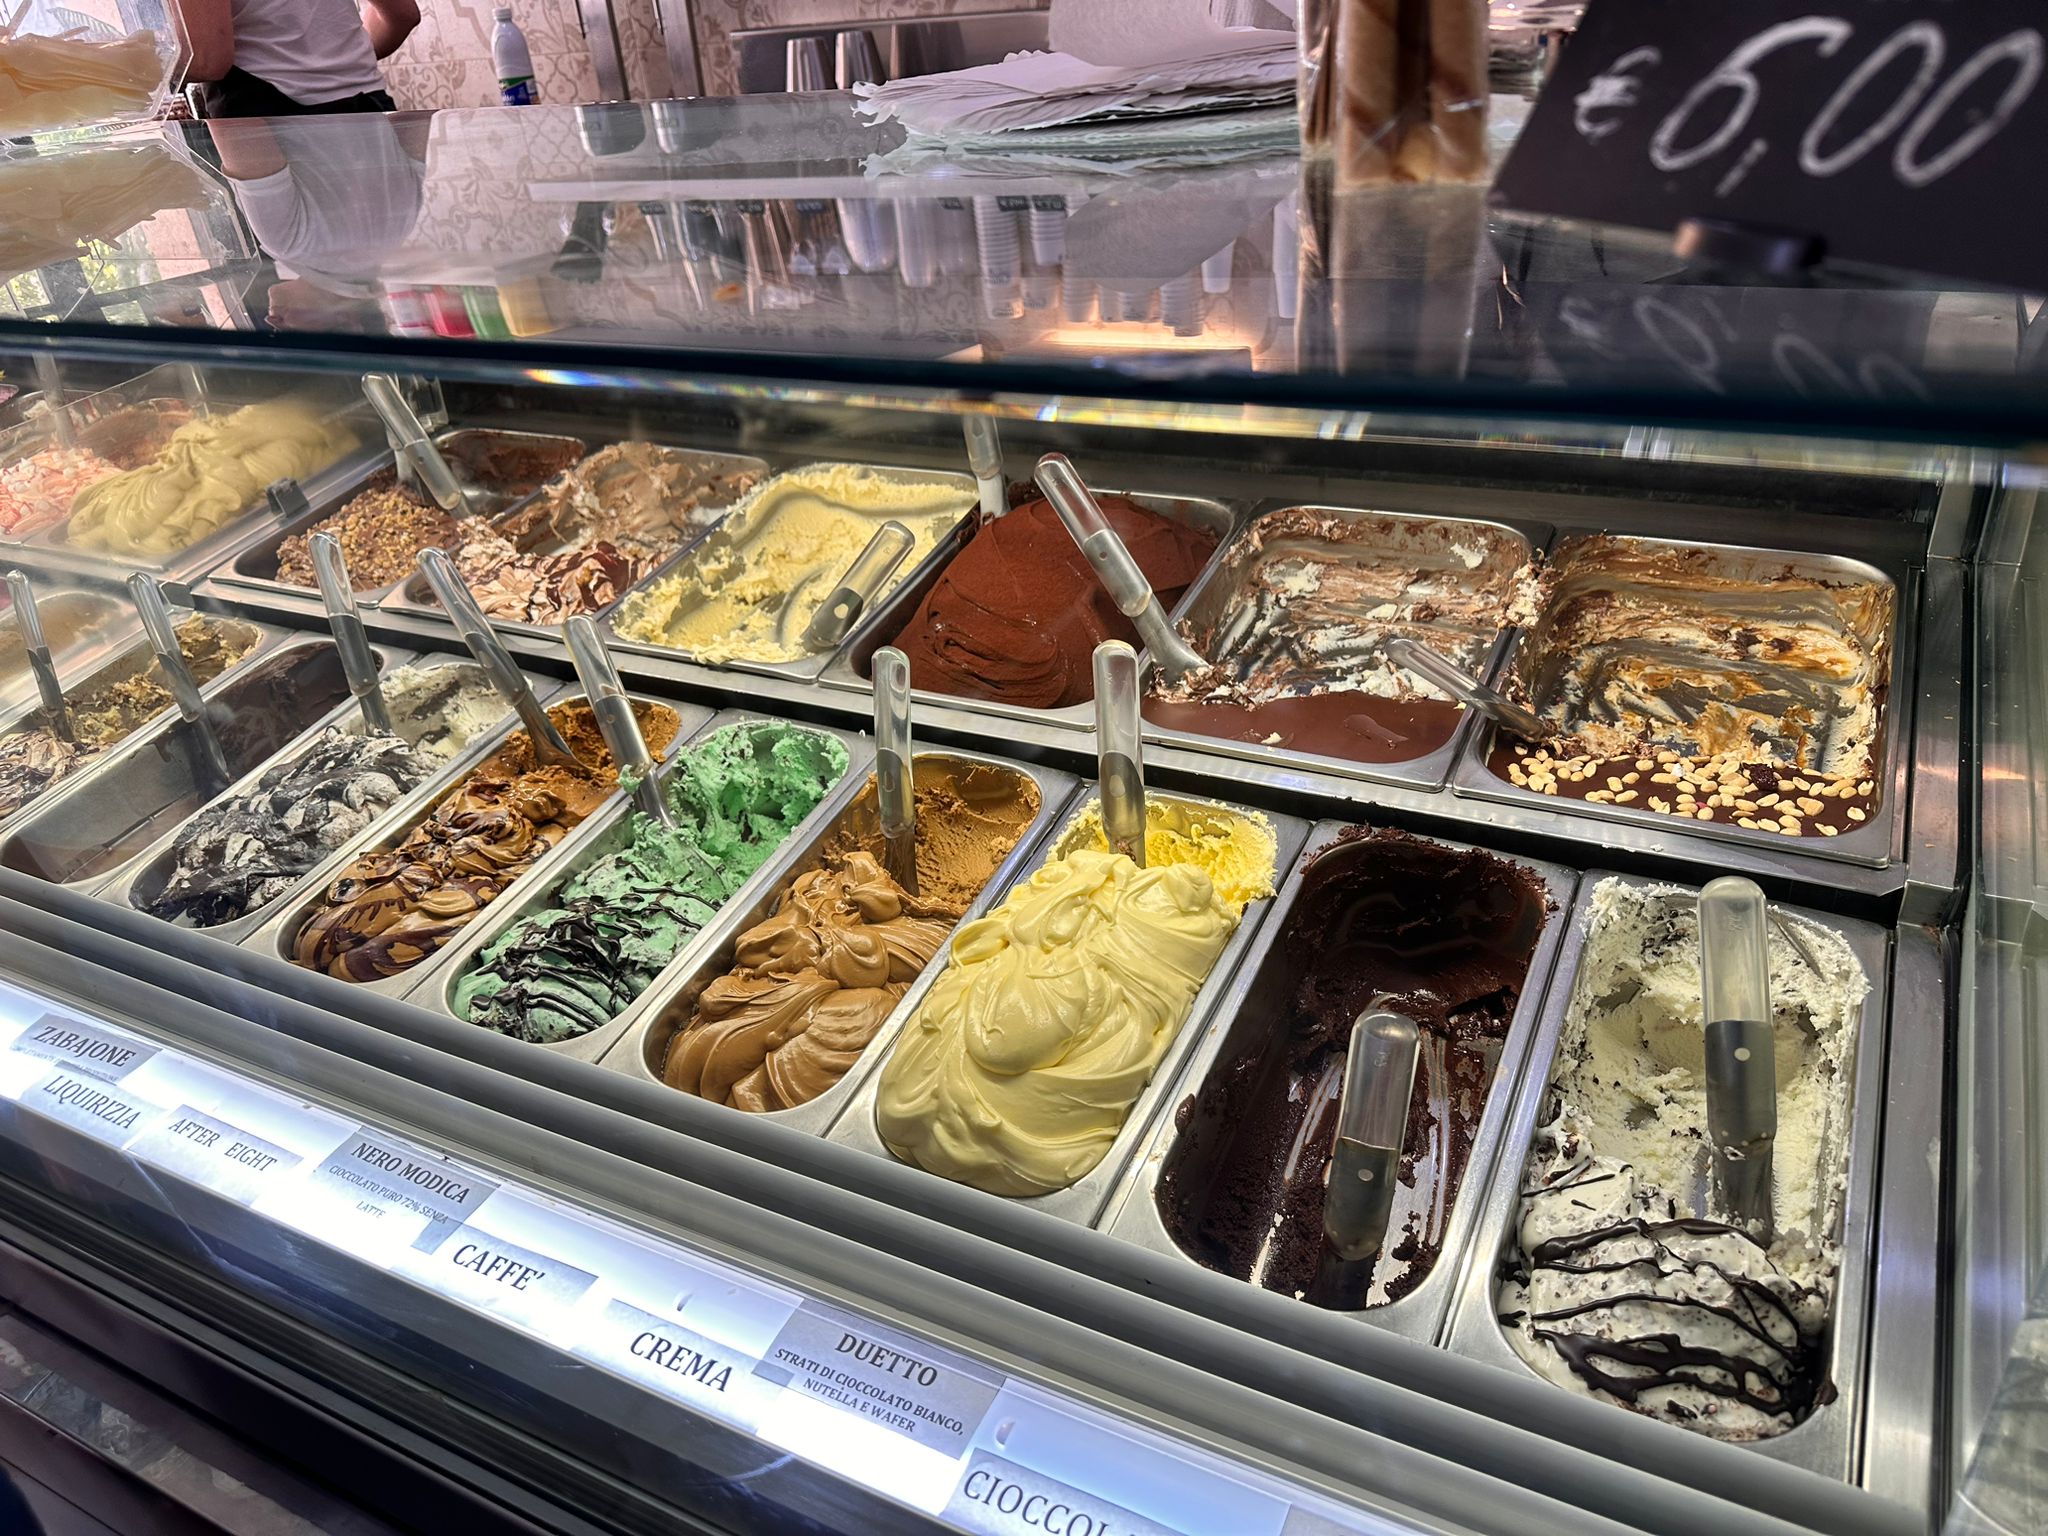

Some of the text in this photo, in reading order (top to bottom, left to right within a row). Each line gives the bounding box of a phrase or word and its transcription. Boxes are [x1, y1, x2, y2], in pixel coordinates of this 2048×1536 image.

[1575, 15, 2045, 196] € 6,00
[33, 1026, 137, 1068] ZABAJONE
[43, 1075, 141, 1129] LIQUIRIZIA
[168, 1118, 278, 1171] AFTER EIGHT
[328, 1165, 449, 1225] CIOCCOLATO PURO 72% SENZA
[351, 1142, 470, 1204] NERO MODICA
[356, 1200, 387, 1219] LATTE
[452, 1244, 546, 1291] CAFFE'
[629, 1331, 733, 1392] CREMA
[835, 1333, 938, 1387] DUETTO
[775, 1348, 964, 1436] STRATI DI CIOCCOLATO BIANCO,
[803, 1377, 916, 1433] NUTELLA E WAFER
